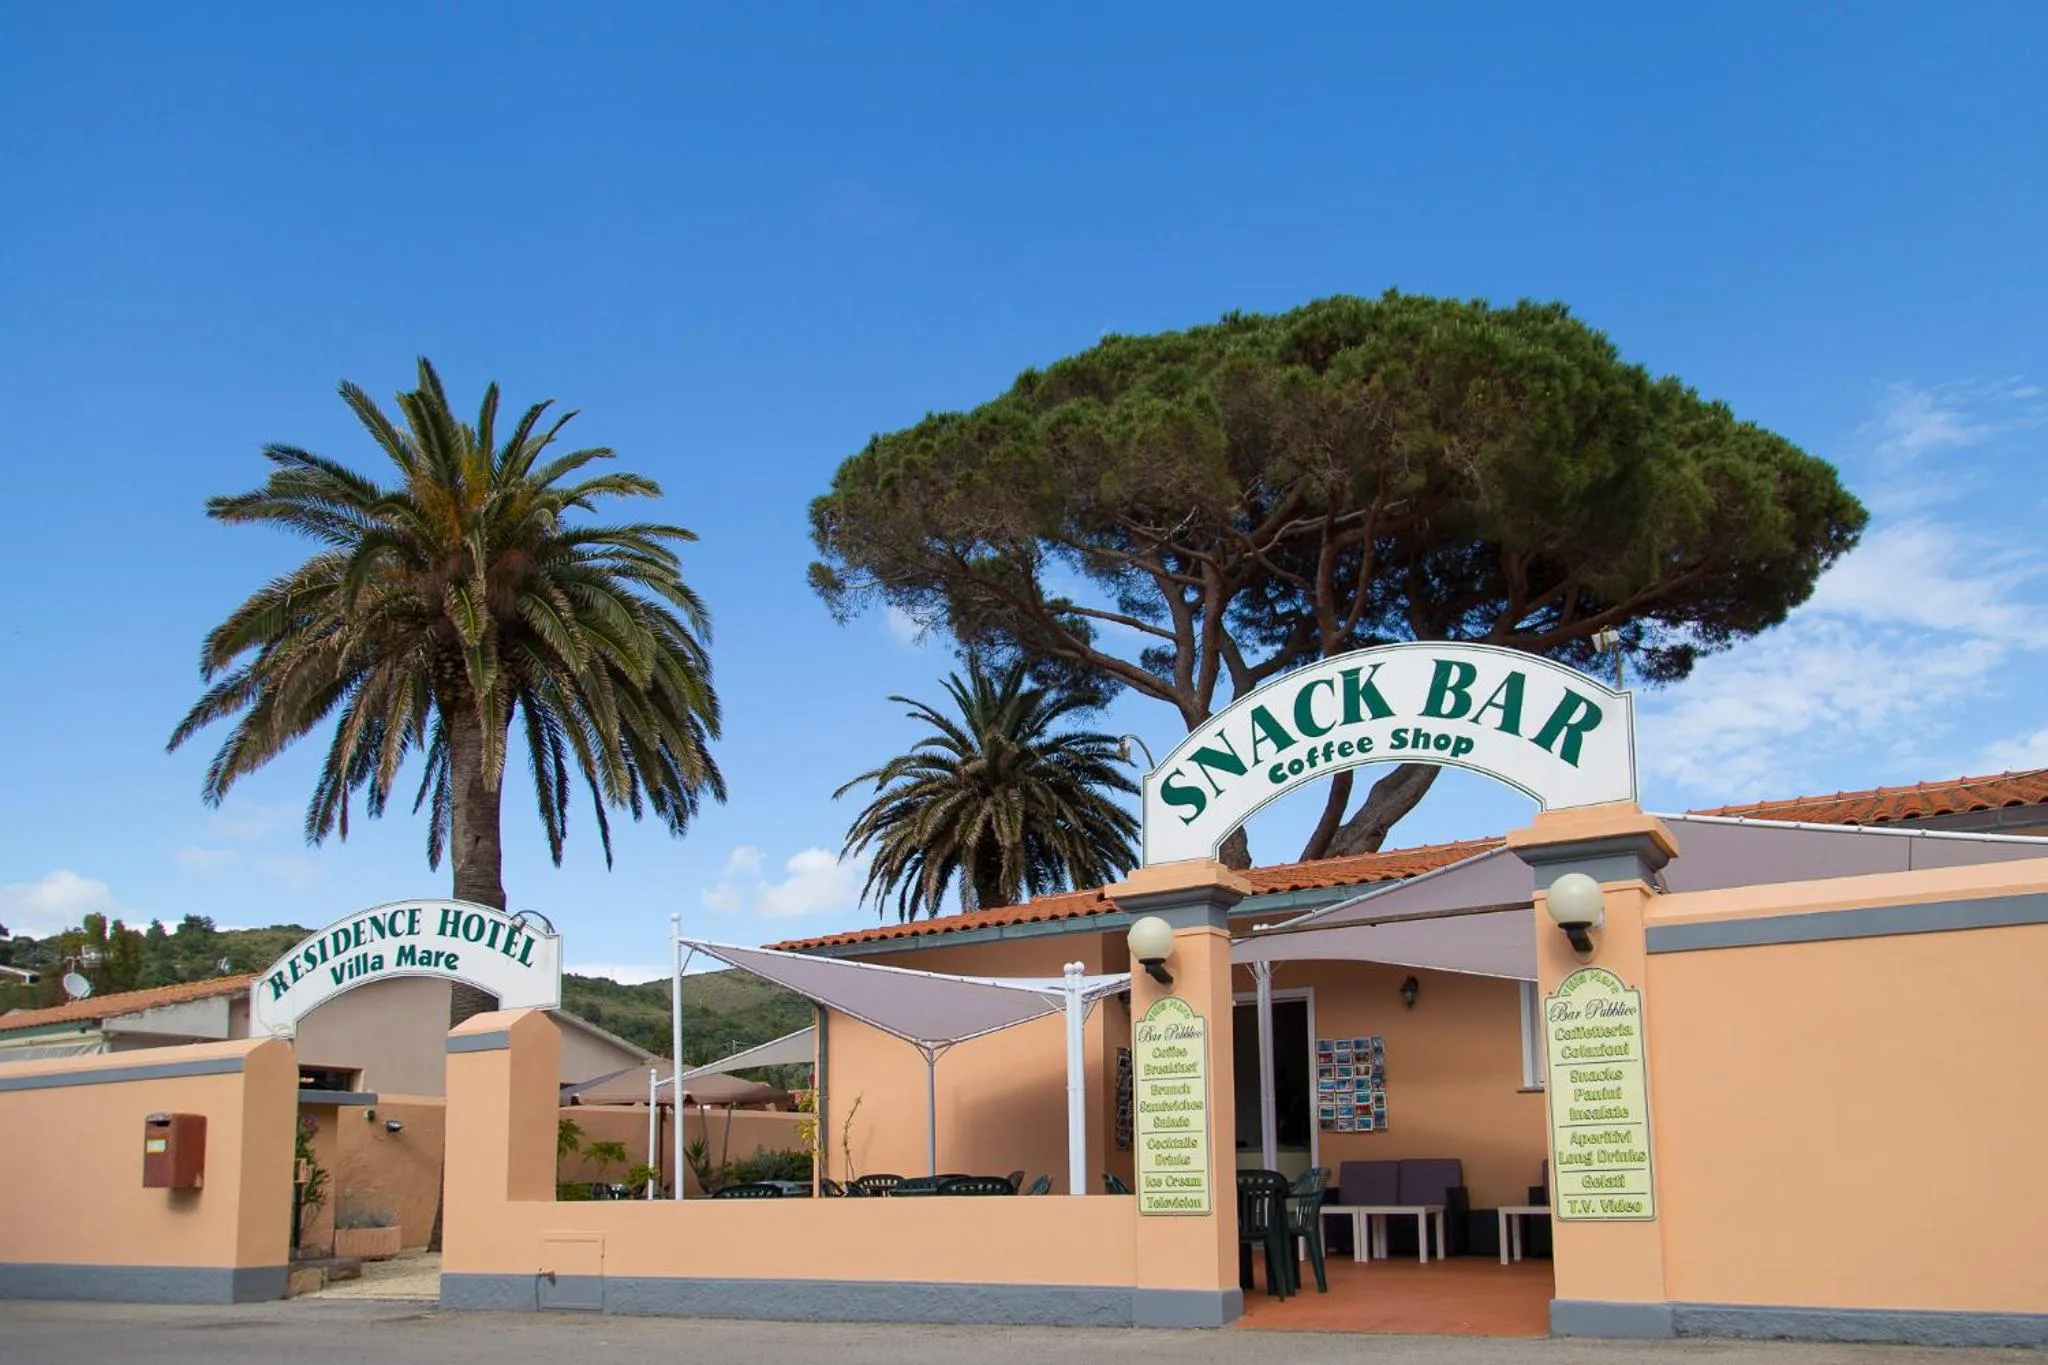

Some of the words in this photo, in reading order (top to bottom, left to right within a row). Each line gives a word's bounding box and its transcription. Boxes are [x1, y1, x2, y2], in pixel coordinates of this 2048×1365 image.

[1160, 661, 1397, 826] SNACK
[1418, 659, 1603, 768] BAR
[1268, 734, 1374, 785] Coffee
[1389, 727, 1475, 758] Shop
[267, 908, 422, 1000] RESIDENCE
[436, 908, 538, 968] HOTEL
[330, 951, 385, 986] Villa
[396, 944, 460, 971] Mare
[1549, 1001, 1581, 1023] Bar
[1585, 997, 1637, 1020] Pubblico
[1138, 1024, 1162, 1043] Bar
[1164, 1023, 1202, 1040] Pubblico
[1555, 1024, 1634, 1041] Caffetteria
[1152, 1045, 1188, 1058] Coffee
[1561, 1041, 1630, 1059] Colazioni
[1144, 1061, 1197, 1075] Breakfast
[1569, 1067, 1624, 1083] Snacks
[1150, 1083, 1191, 1096] Brunch
[1573, 1086, 1623, 1102] Panini
[1140, 1099, 1203, 1113] Sandwiches
[1569, 1105, 1630, 1121] Insalate
[1153, 1115, 1190, 1128] Salads
[1146, 1136, 1198, 1150] Cocktails
[1570, 1130, 1632, 1147] Aperitivi
[1155, 1153, 1191, 1167] Drinks
[1558, 1150, 1593, 1166] Long
[1597, 1148, 1646, 1163] Drinks
[1145, 1174, 1162, 1187] Ice
[1165, 1174, 1202, 1187] Cream
[1582, 1174, 1626, 1189] Gelati
[1146, 1196, 1202, 1209] Television
[1568, 1199, 1596, 1214] T.V.
[1599, 1198, 1643, 1213] Video
